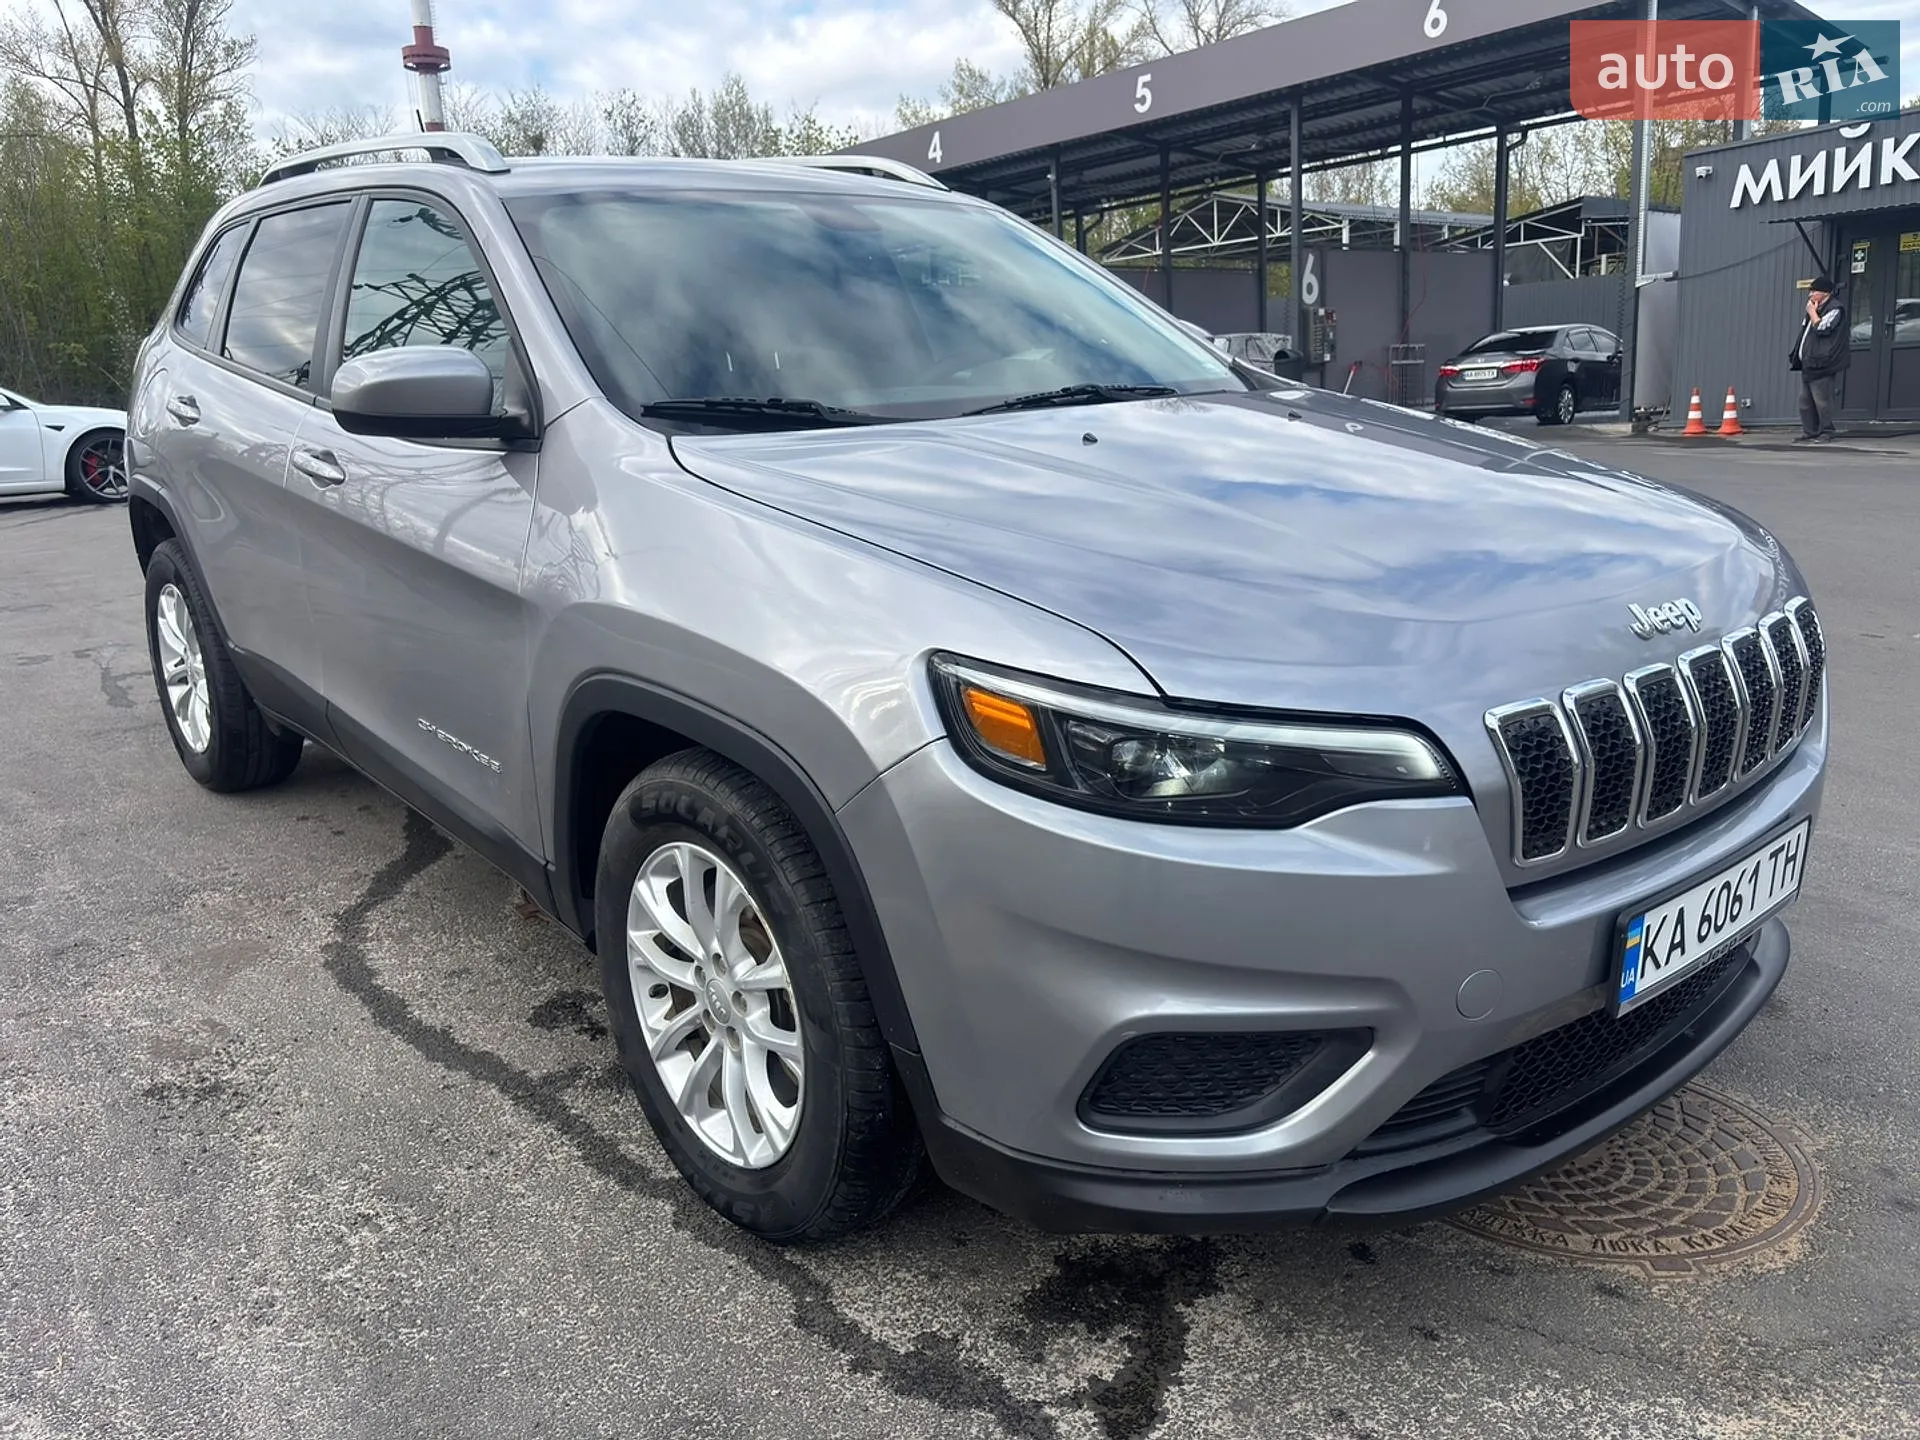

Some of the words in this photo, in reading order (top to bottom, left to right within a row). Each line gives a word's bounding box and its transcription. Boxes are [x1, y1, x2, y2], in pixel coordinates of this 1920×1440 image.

[1423, 0, 1448, 38] 6
[1133, 73, 1152, 114] 5
[927, 130, 943, 164] 4
[1729, 120, 1920, 209] МИЙК
[1301, 253, 1320, 305] 6
[1625, 597, 1703, 641] Jeep
[1640, 906, 1686, 980] KA
[1697, 859, 1761, 944] 6061
[1768, 832, 1801, 898] TH
[1620, 966, 1636, 988] UA
[1591, 1236, 1671, 1254] ЛЮКА
